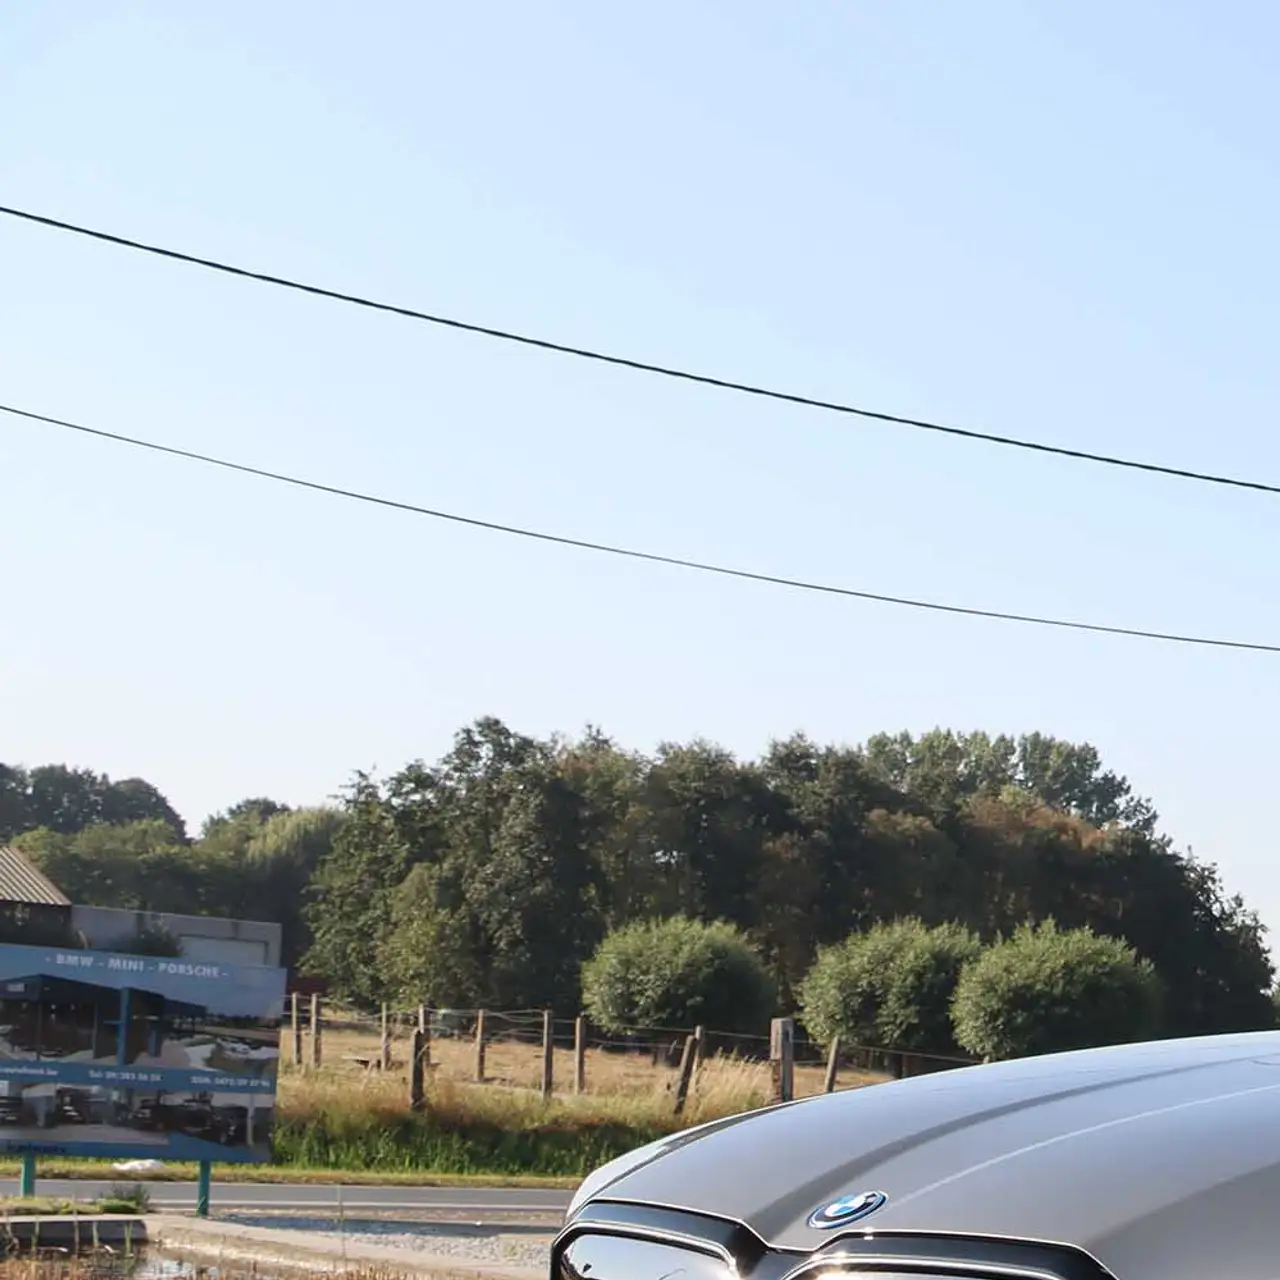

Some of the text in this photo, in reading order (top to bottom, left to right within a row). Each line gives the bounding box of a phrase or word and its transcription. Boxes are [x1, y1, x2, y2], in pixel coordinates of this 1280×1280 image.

[56, 953, 220, 978] BMW MINI PORSCHE
